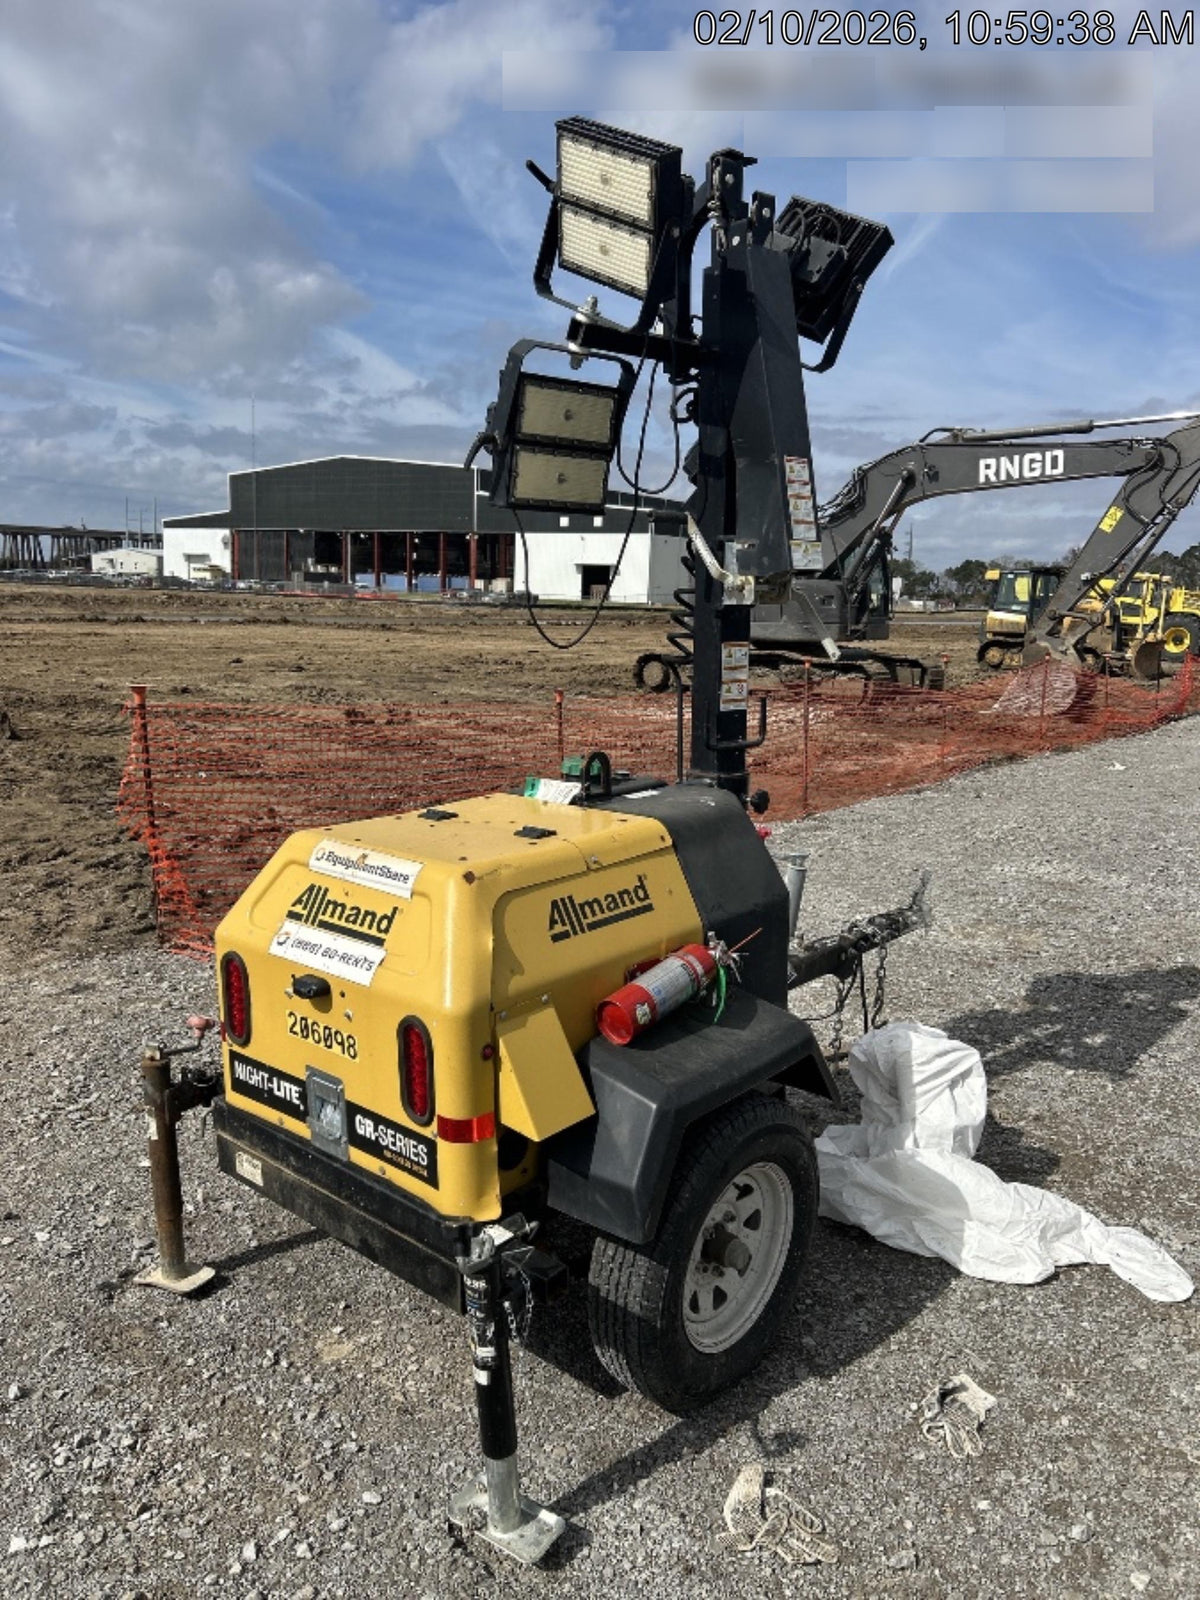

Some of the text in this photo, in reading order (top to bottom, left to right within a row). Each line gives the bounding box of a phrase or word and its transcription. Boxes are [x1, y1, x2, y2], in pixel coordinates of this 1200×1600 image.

[979, 449, 1065, 485] RNGD
[290, 883, 398, 935] Allmand
[548, 873, 650, 936] Allmand
[287, 1011, 358, 1060] 206098
[355, 1114, 428, 1166] GR-SERIES
